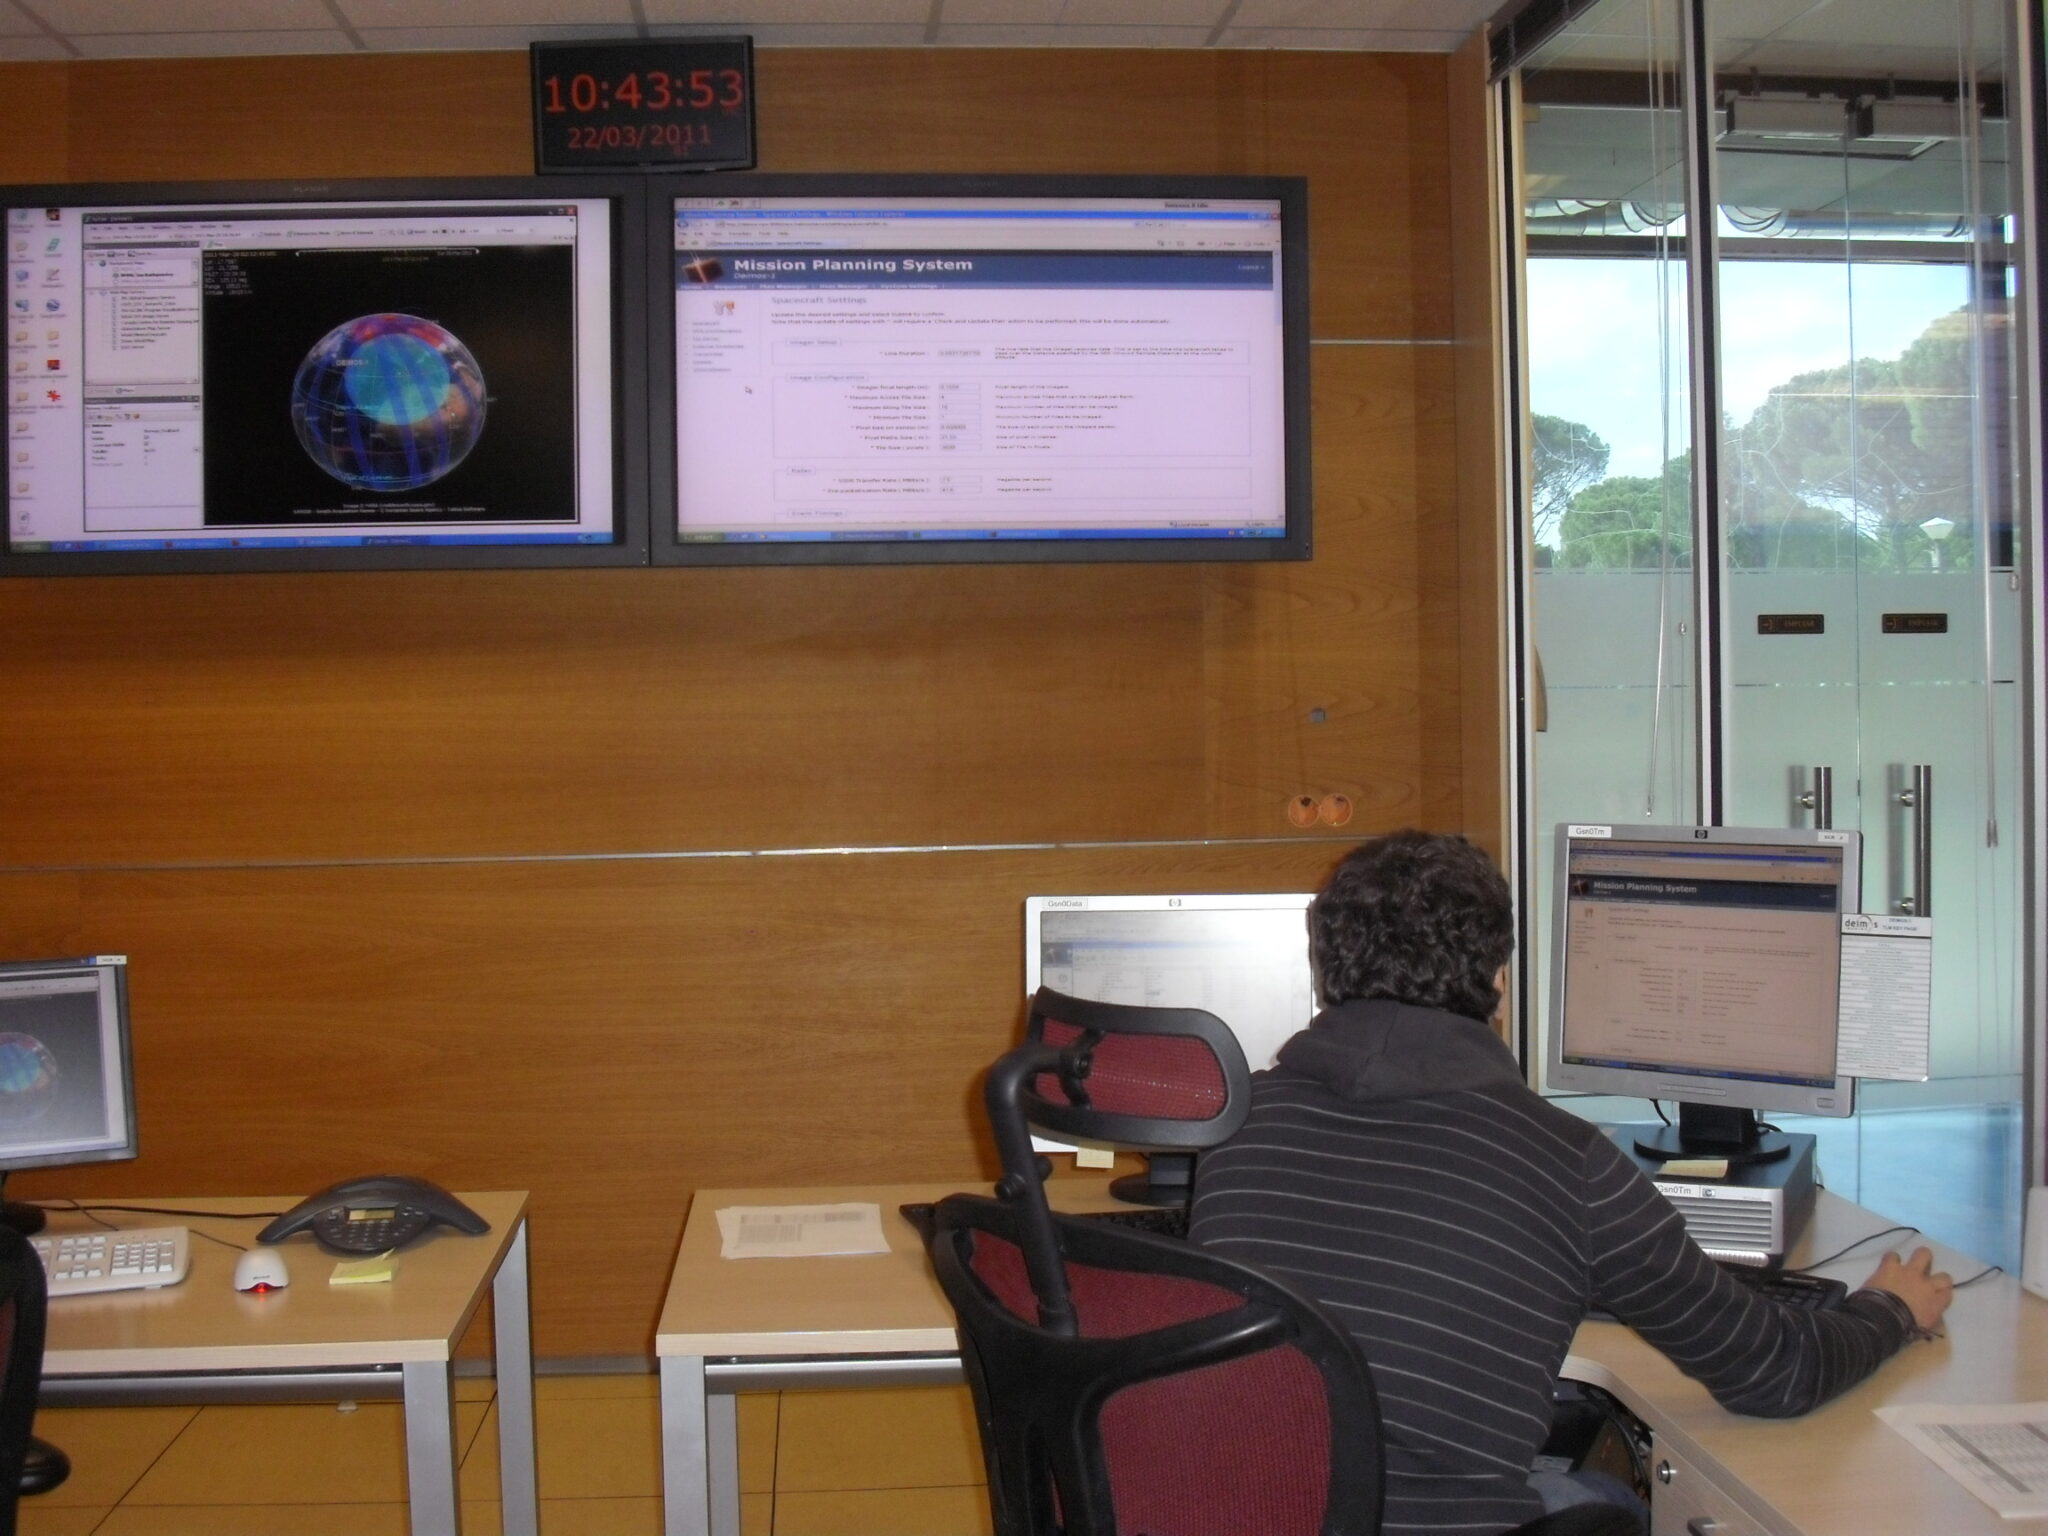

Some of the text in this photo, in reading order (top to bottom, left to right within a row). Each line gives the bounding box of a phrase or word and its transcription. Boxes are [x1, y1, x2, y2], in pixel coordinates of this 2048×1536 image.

[544, 68, 744, 113] 10:43:53
[567, 123, 712, 149] 22/03/2011
[734, 258, 973, 273] Mission Planning System
[772, 296, 867, 305] Spacecraft Settings
[1593, 881, 1698, 894] Mission Planning System
